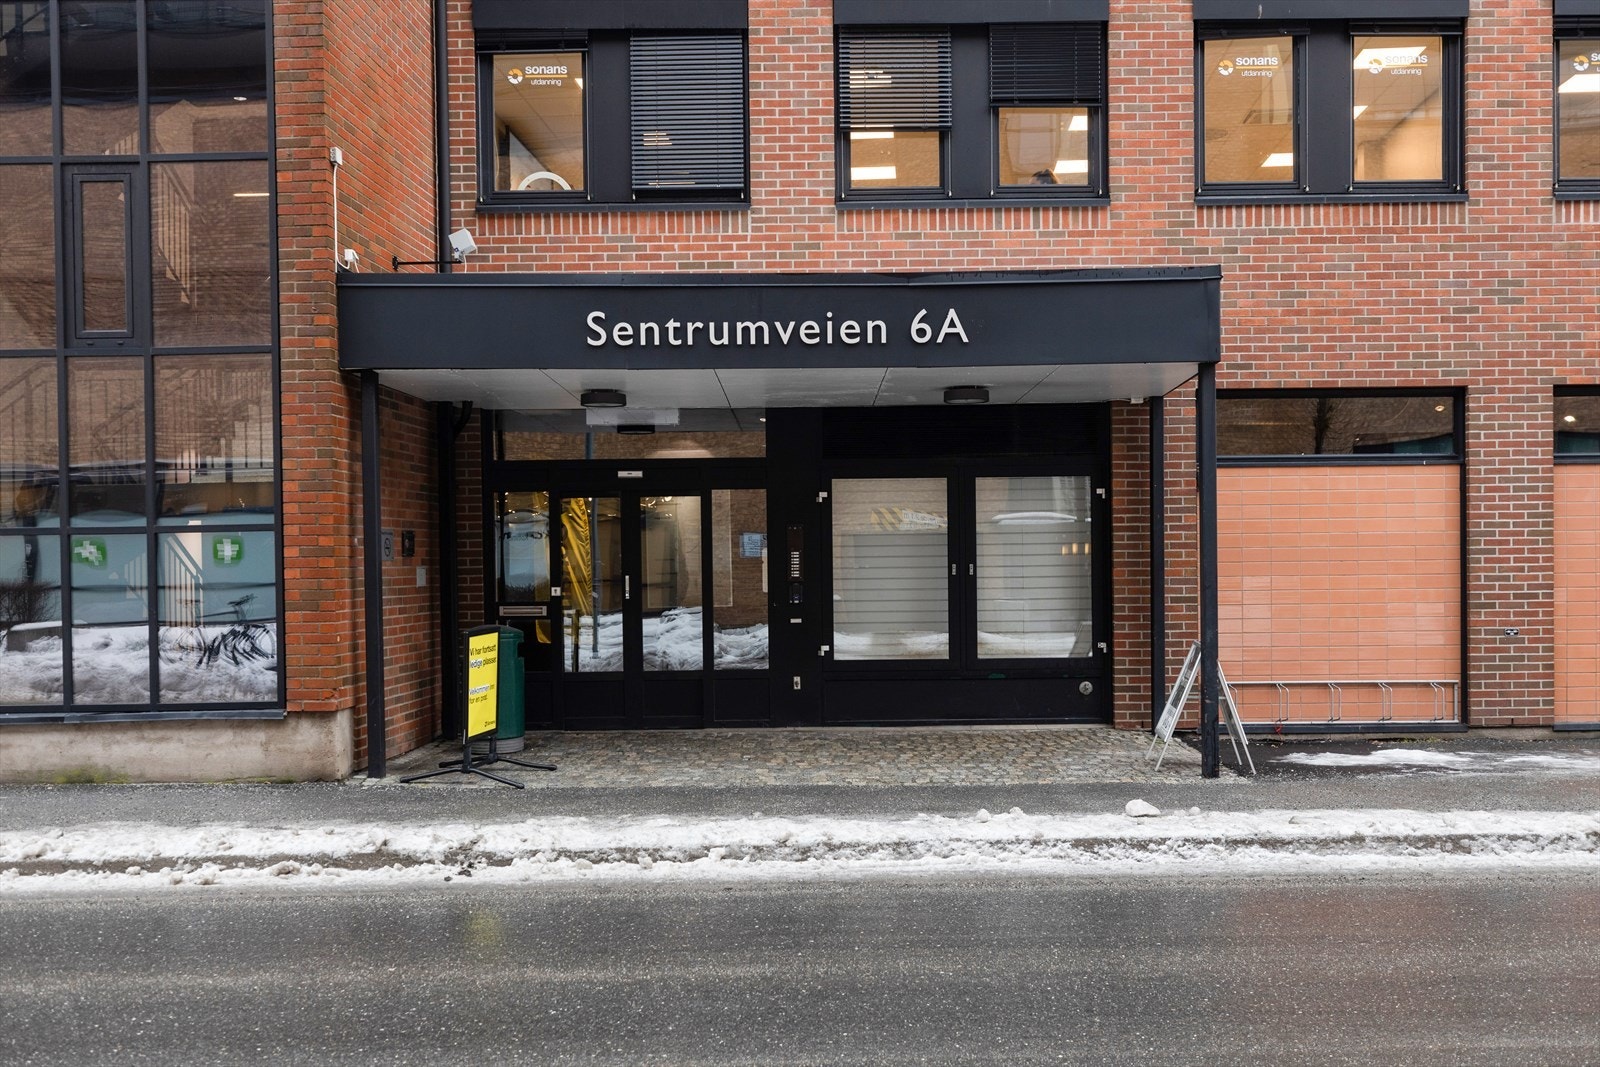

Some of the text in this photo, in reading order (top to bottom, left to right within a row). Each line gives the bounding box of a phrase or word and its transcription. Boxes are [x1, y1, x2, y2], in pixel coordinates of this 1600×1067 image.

[1235, 57, 1279, 66] sonans
[1385, 55, 1428, 64] sonans
[525, 65, 568, 74] sonans
[1241, 70, 1273, 78] utdanning
[530, 78, 562, 86] utdanning
[586, 308, 969, 346] Sentrumveien 6A
